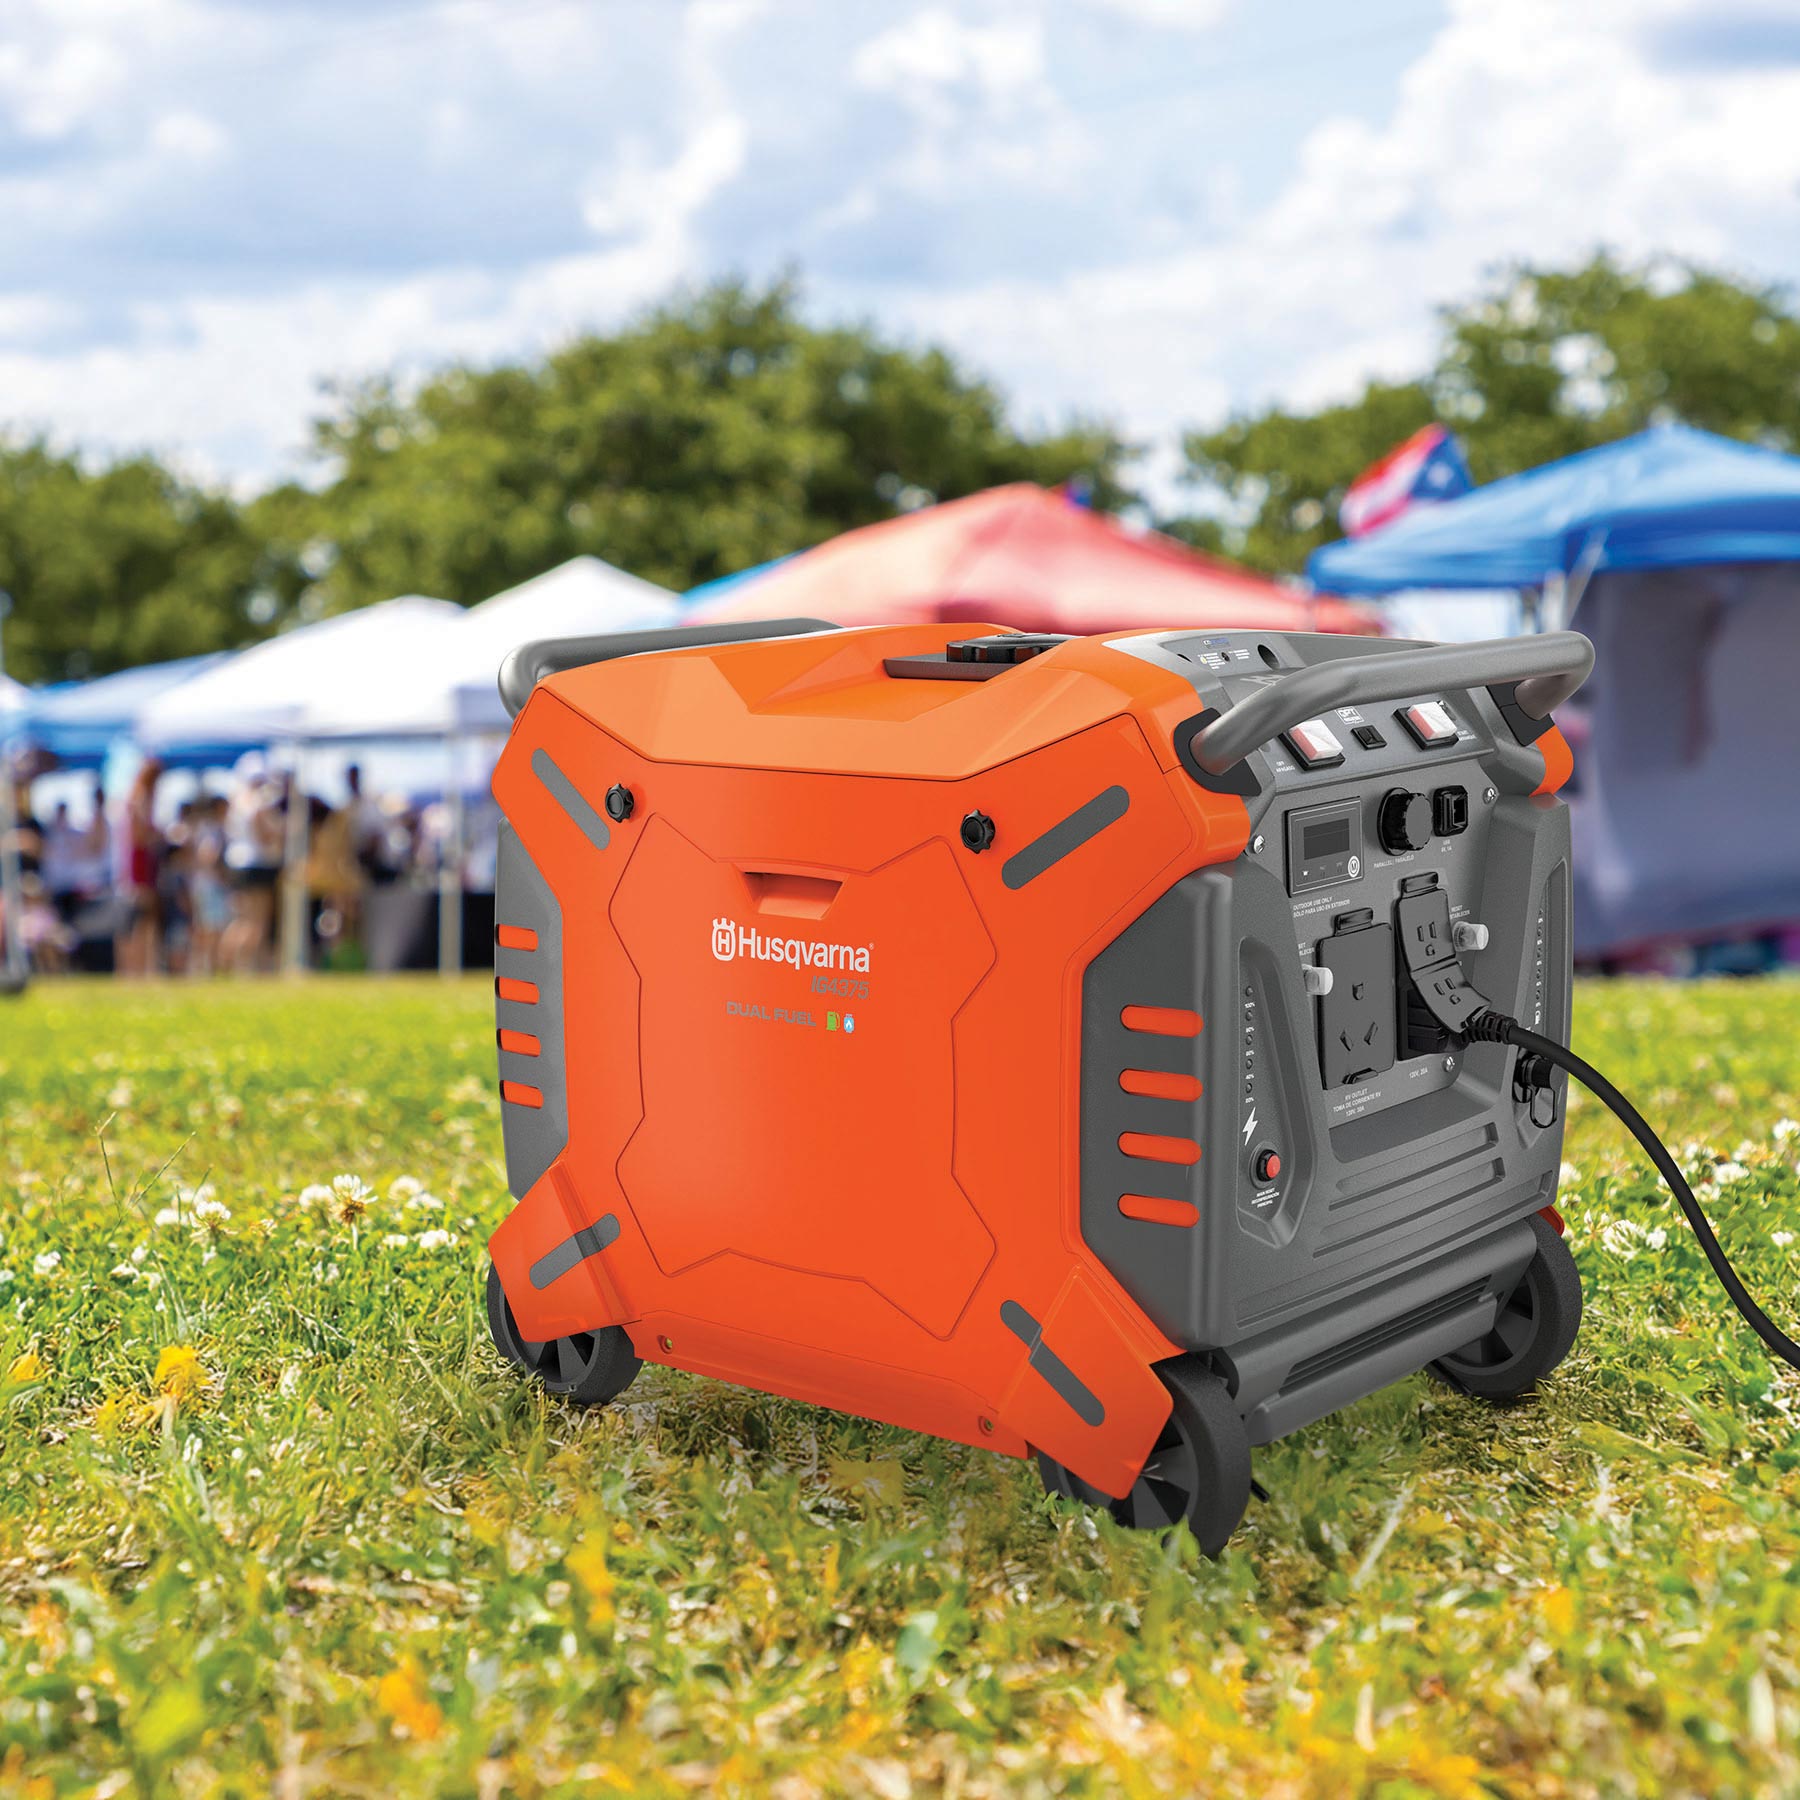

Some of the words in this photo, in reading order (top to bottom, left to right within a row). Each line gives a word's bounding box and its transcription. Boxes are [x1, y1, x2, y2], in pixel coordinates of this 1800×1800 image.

[738, 926, 870, 972] Husqvarna
[811, 975, 869, 1000] IG4375
[726, 1001, 771, 1020] DUAL
[773, 1008, 816, 1027] FUEL
